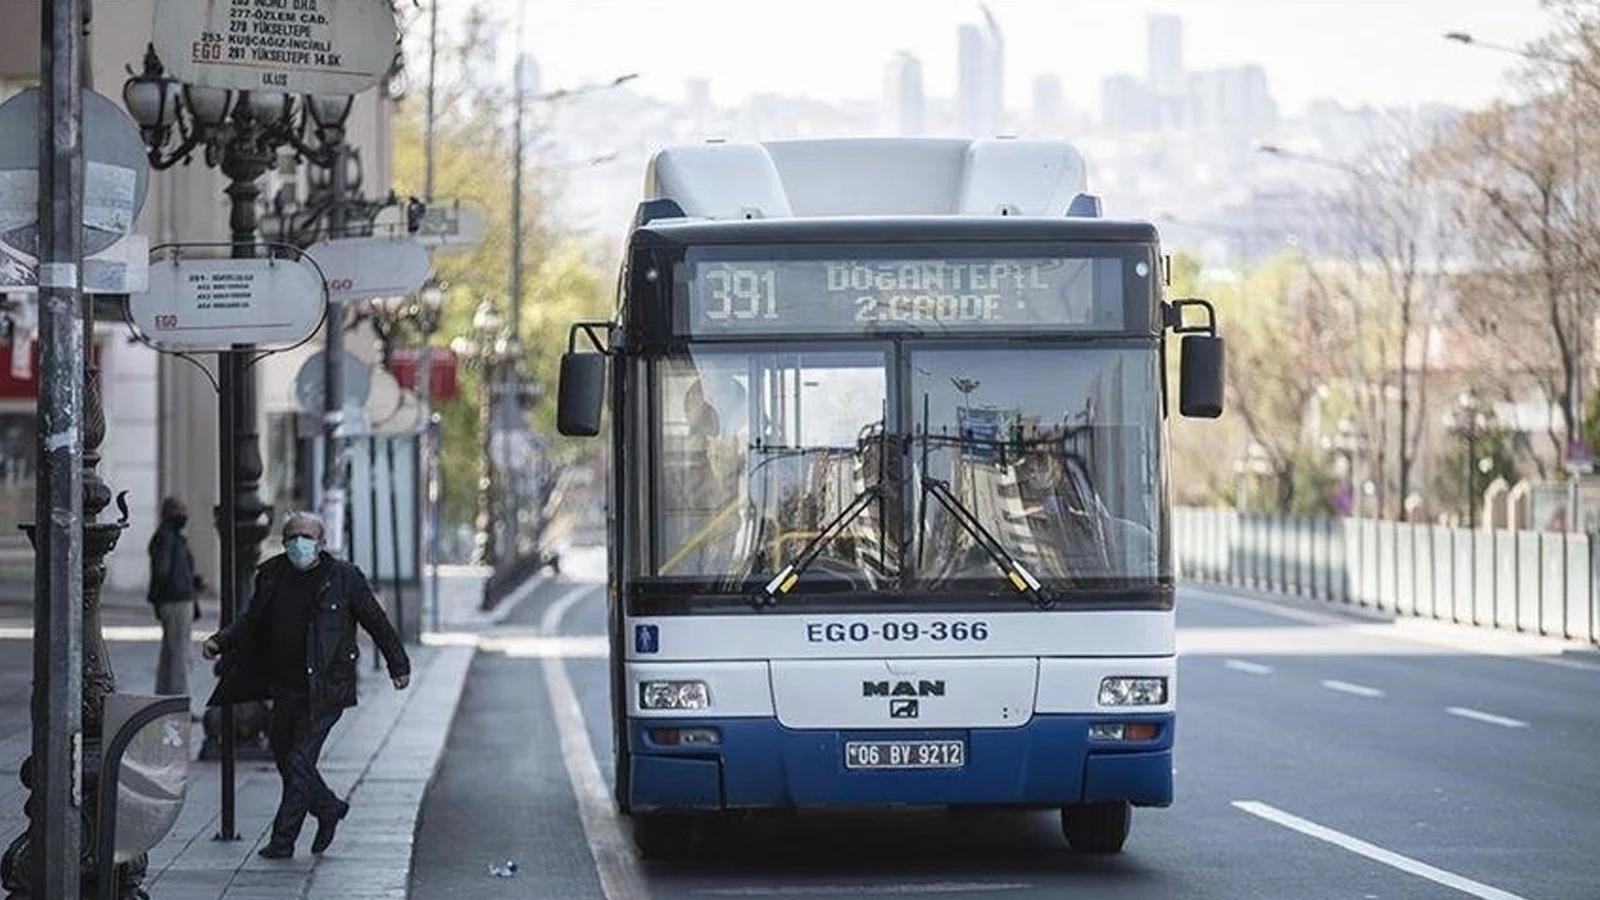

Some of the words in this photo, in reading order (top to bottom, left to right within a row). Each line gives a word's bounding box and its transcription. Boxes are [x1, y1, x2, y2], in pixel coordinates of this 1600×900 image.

[192, 42, 221, 60] EGO
[328, 279, 353, 291] GO
[706, 270, 778, 319] 391
[807, 621, 989, 642] EGO-09-366
[862, 680, 946, 697] MAN
[859, 745, 880, 765] 06
[919, 744, 961, 764] 9212
